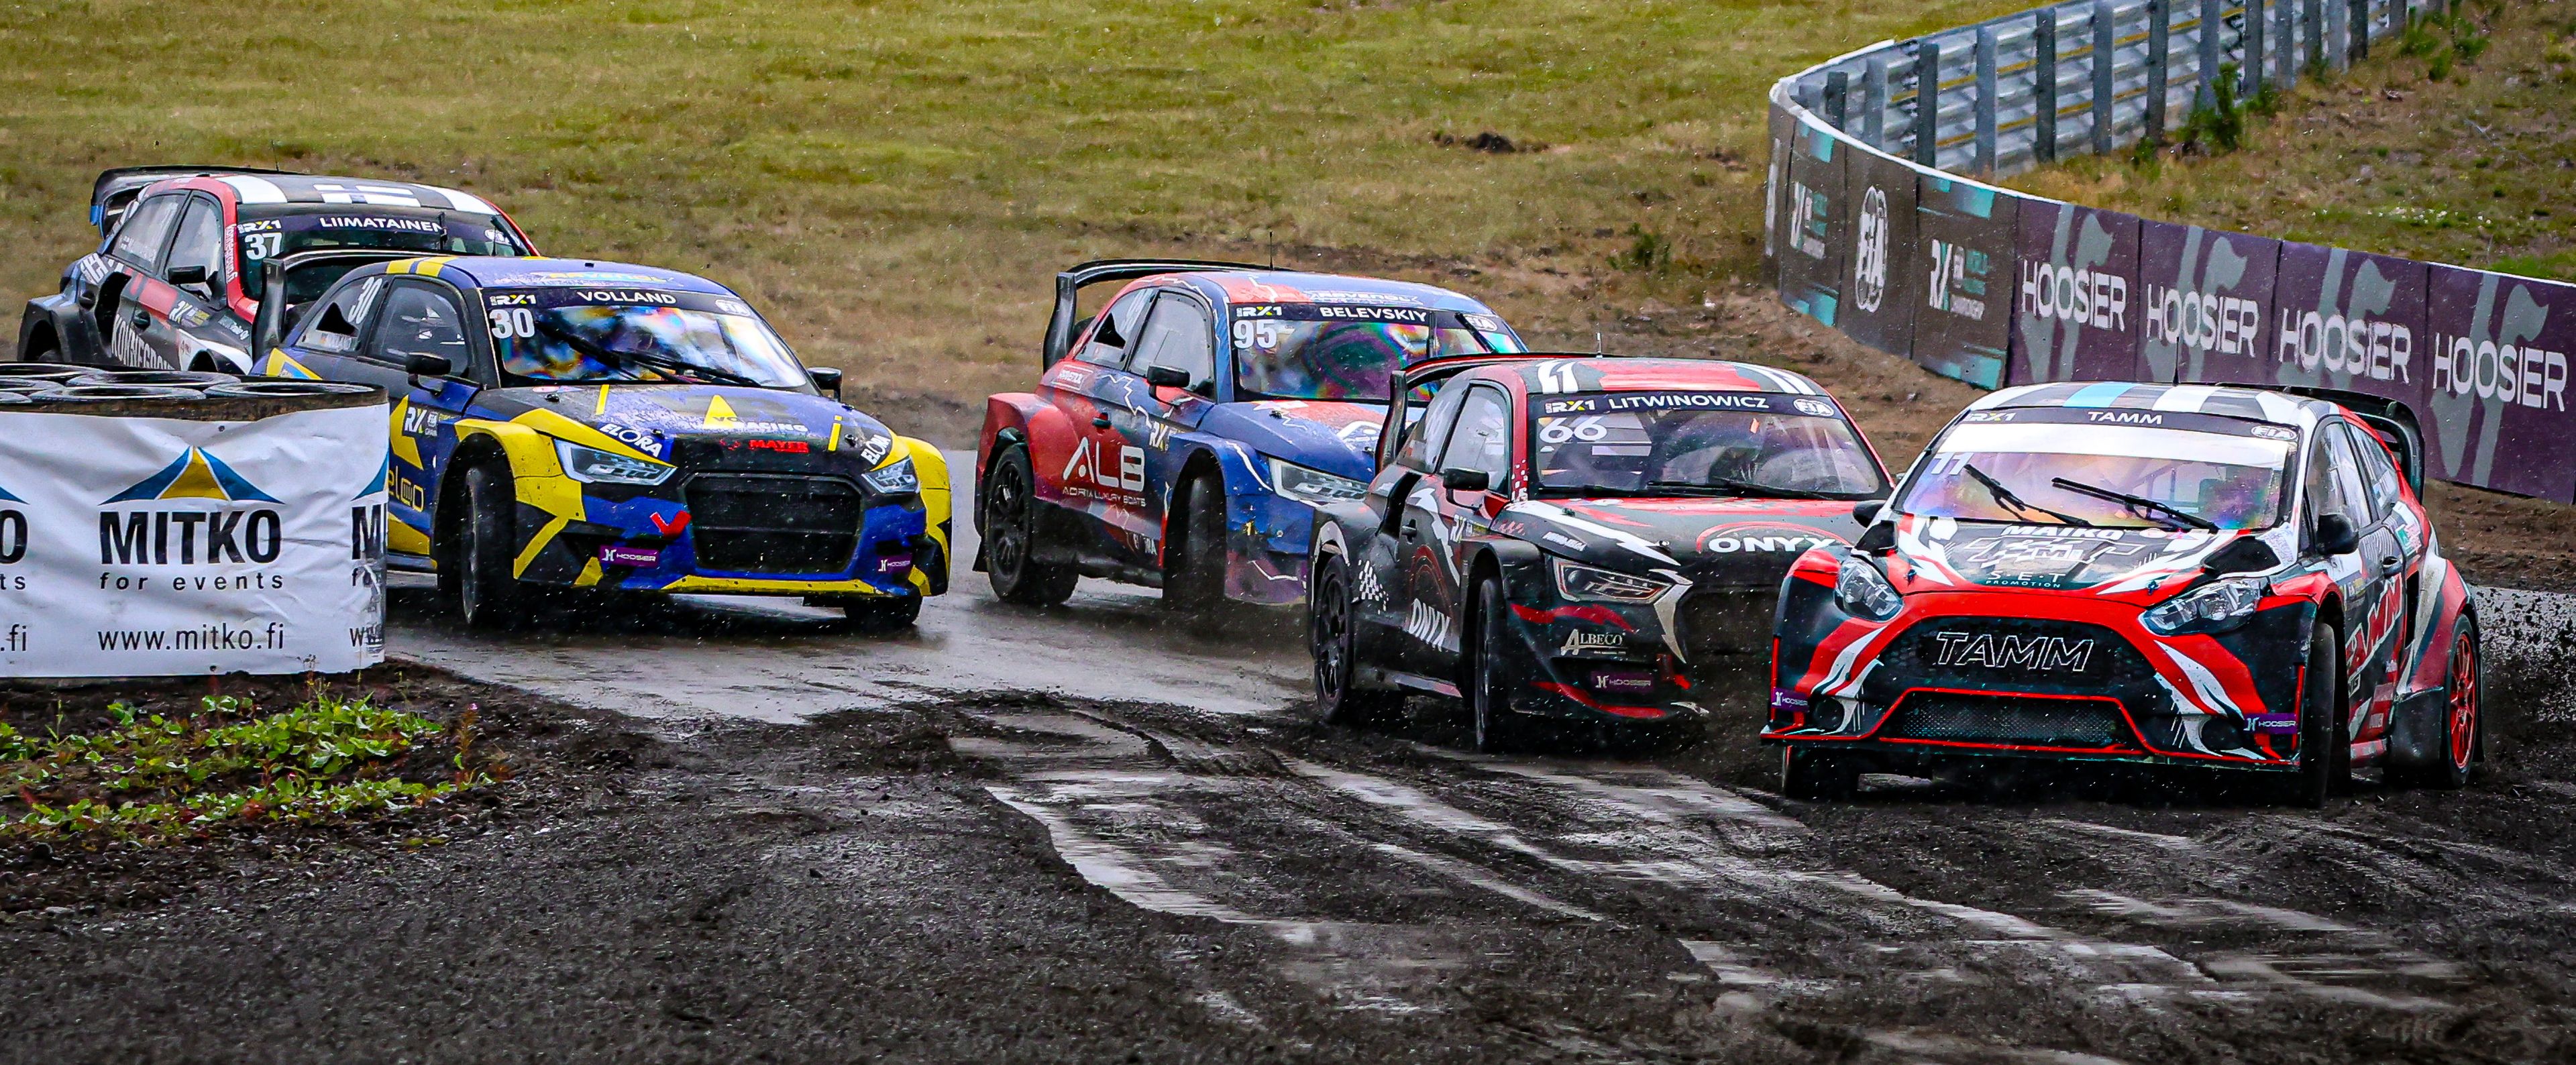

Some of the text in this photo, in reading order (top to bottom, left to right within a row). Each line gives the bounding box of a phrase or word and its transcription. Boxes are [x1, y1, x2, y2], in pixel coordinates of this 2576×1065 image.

[244, 232, 282, 260] 37
[347, 276, 382, 324] 30
[577, 291, 676, 304] VOLLAND
[2022, 260, 2127, 331] HOOSIER
[489, 308, 535, 339] 30
[1319, 306, 1427, 322] BELEVSKIY
[2147, 283, 2259, 357] HOOSIER
[1233, 319, 1277, 349] 95
[2279, 309, 2411, 384] HOOSIER
[2432, 332, 2569, 412] HOOSIER
[1609, 396, 1770, 409] LITWINOWICZ
[1540, 416, 1608, 443] 66
[2088, 411, 2163, 425] TAMM
[600, 423, 663, 458] ELORA
[861, 434, 891, 465] ELORA
[1063, 437, 1145, 492] ALB
[1929, 452, 1974, 475] 11
[99, 509, 282, 565] MITKO
[1709, 535, 1836, 553] ONYX
[2000, 525, 2125, 541] MAIKO
[100, 571, 283, 591] for events
[1985, 579, 2061, 588] PROMOTION
[98, 622, 284, 651] www.mitko.fi
[1409, 598, 1452, 653] ONYX
[1936, 632, 2094, 671] TAMM
